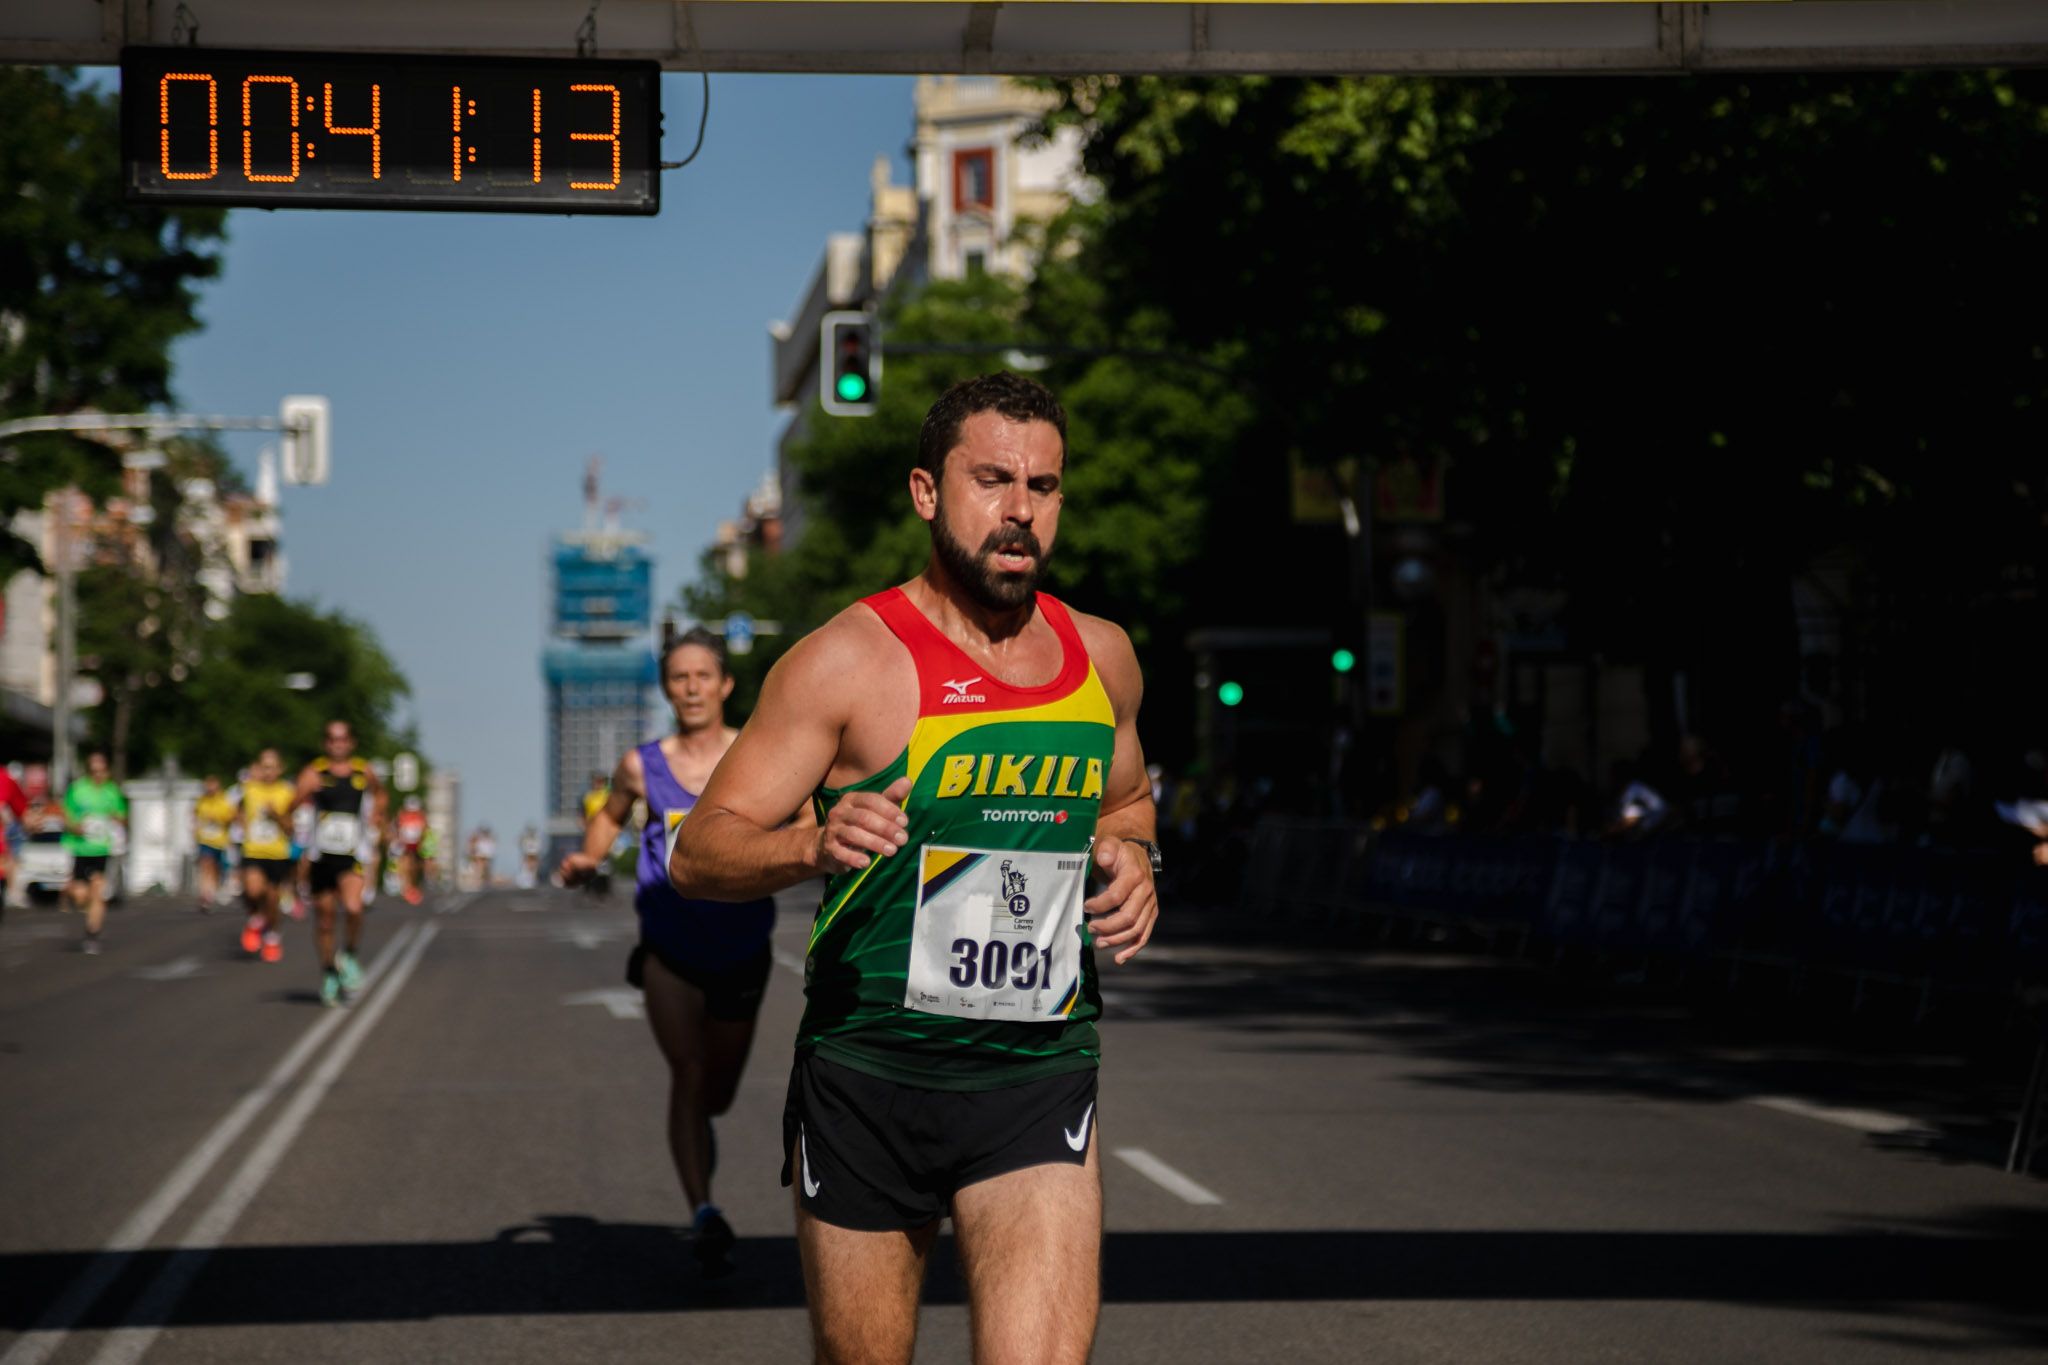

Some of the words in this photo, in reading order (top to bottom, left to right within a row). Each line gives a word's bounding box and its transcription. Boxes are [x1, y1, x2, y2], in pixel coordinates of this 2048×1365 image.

[160, 73, 621, 189] 00:41:13
[936, 754, 1103, 799] BIKILA
[1013, 900, 1026, 912] 13
[950, 938, 1053, 990] 3091
